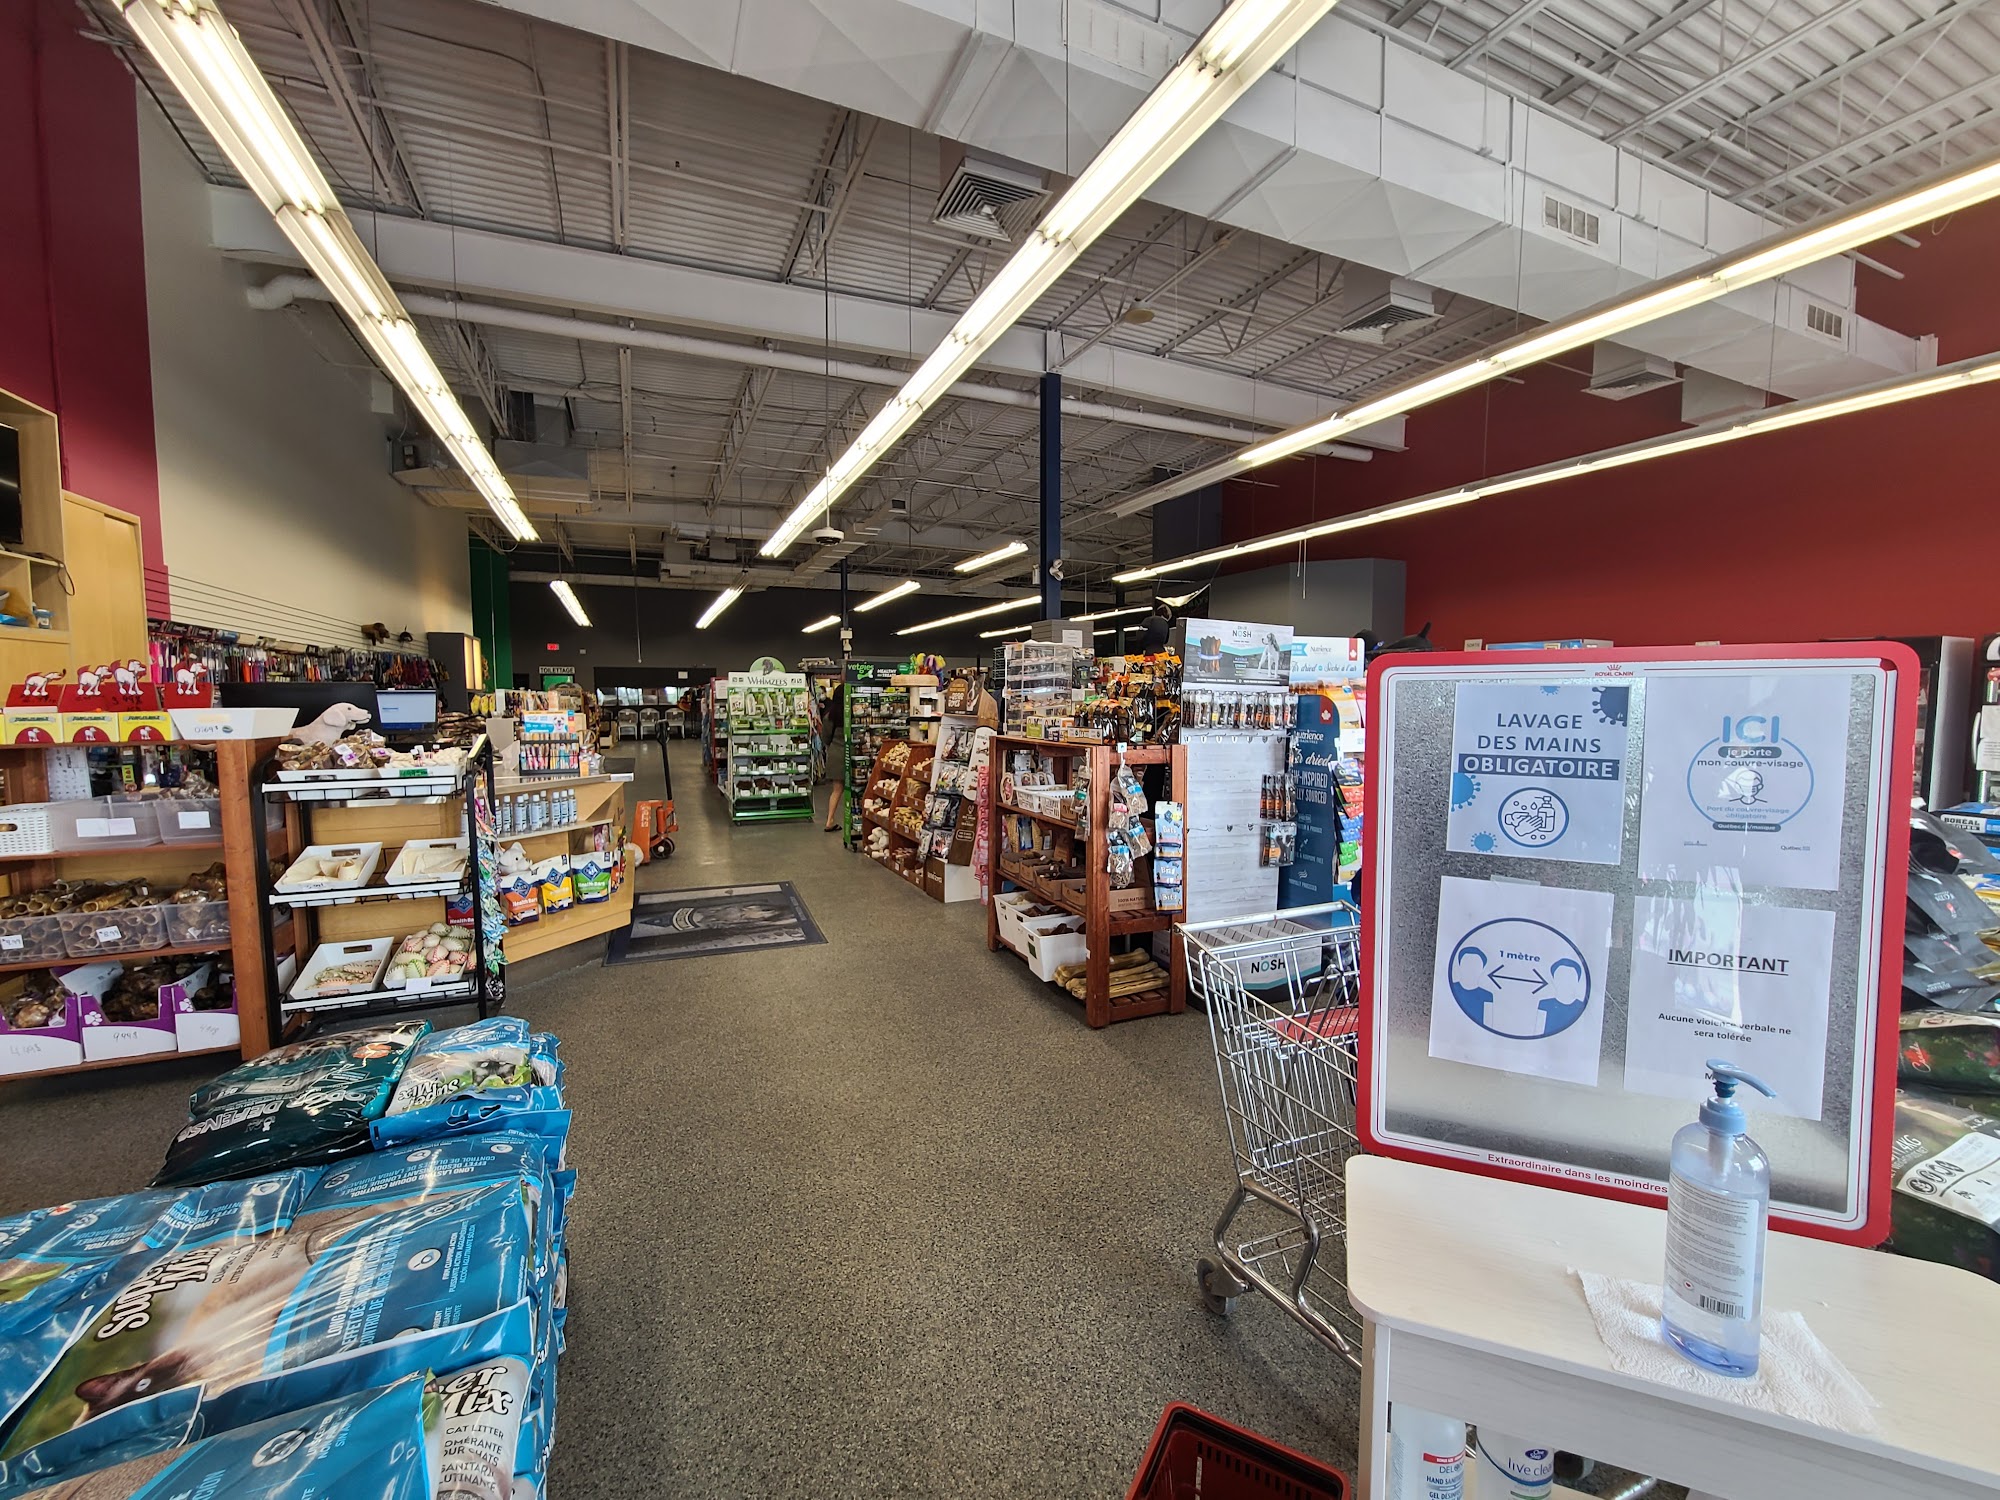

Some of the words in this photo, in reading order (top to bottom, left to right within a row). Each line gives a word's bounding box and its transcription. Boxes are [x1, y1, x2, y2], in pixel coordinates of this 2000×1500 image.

[1232, 629, 1252, 638] NOSH
[1497, 713, 1583, 729] LAVAGE
[1295, 731, 1324, 741] utrience
[1722, 715, 1780, 744] ICI
[1477, 735, 1516, 750] DES
[1525, 736, 1601, 753] MAINS
[1742, 748, 1773, 758] porte
[1463, 756, 1614, 778] OBLIGATOIRE
[1724, 759, 1804, 768] couvre-visage
[1507, 952, 1541, 962] mètre
[1668, 949, 1790, 973] IMPORTANT
[1251, 958, 1286, 974] NOSH
[1658, 1012, 1694, 1024] Aucune
[1740, 1022, 1776, 1033] verbale
[1778, 1027, 1792, 1035] ne
[1694, 1029, 1714, 1038] sera
[1717, 1030, 1752, 1043] tolérée
[1487, 1154, 1561, 1174] Extraordinaire
[1565, 1168, 1591, 1180] dans
[1595, 1173, 1611, 1183] les
[1614, 1178, 1668, 1194] moindres
[440, 1366, 508, 1394] er
[446, 1425, 469, 1435] CAT
[472, 1424, 504, 1440] LITTER
[445, 1437, 503, 1455] OMÉRANTE
[1508, 1458, 1531, 1476] live
[1426, 1475, 1444, 1485] HAND
